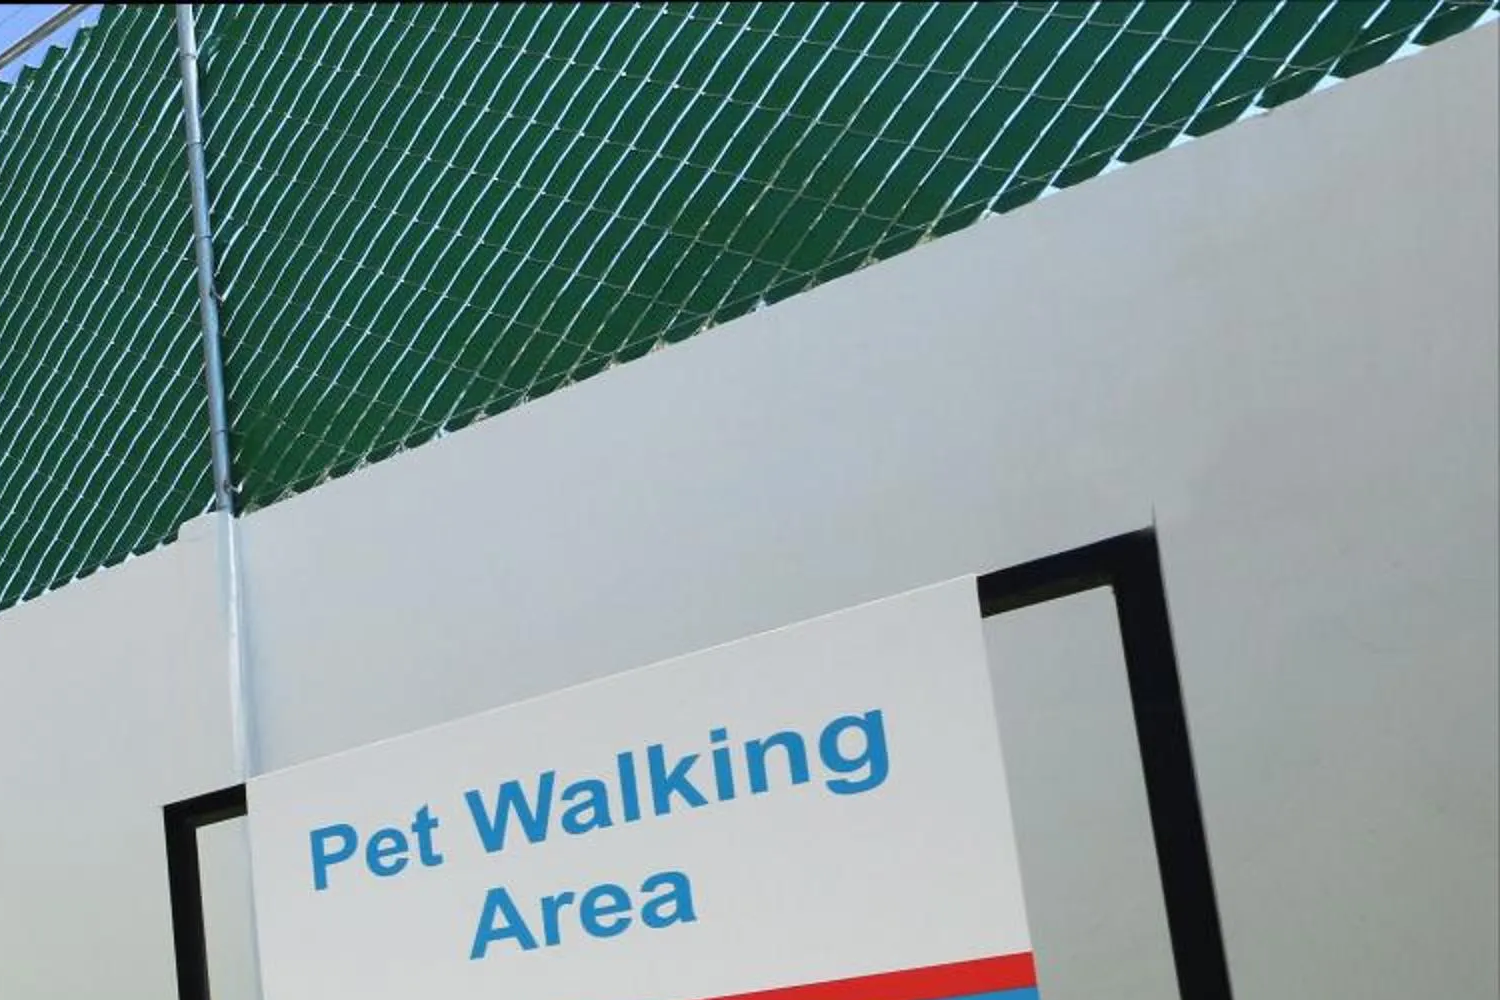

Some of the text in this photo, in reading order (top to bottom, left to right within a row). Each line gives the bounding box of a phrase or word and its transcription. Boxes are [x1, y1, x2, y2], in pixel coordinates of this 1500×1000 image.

[308, 708, 891, 891] Pet Walking
[468, 867, 698, 962] Area
